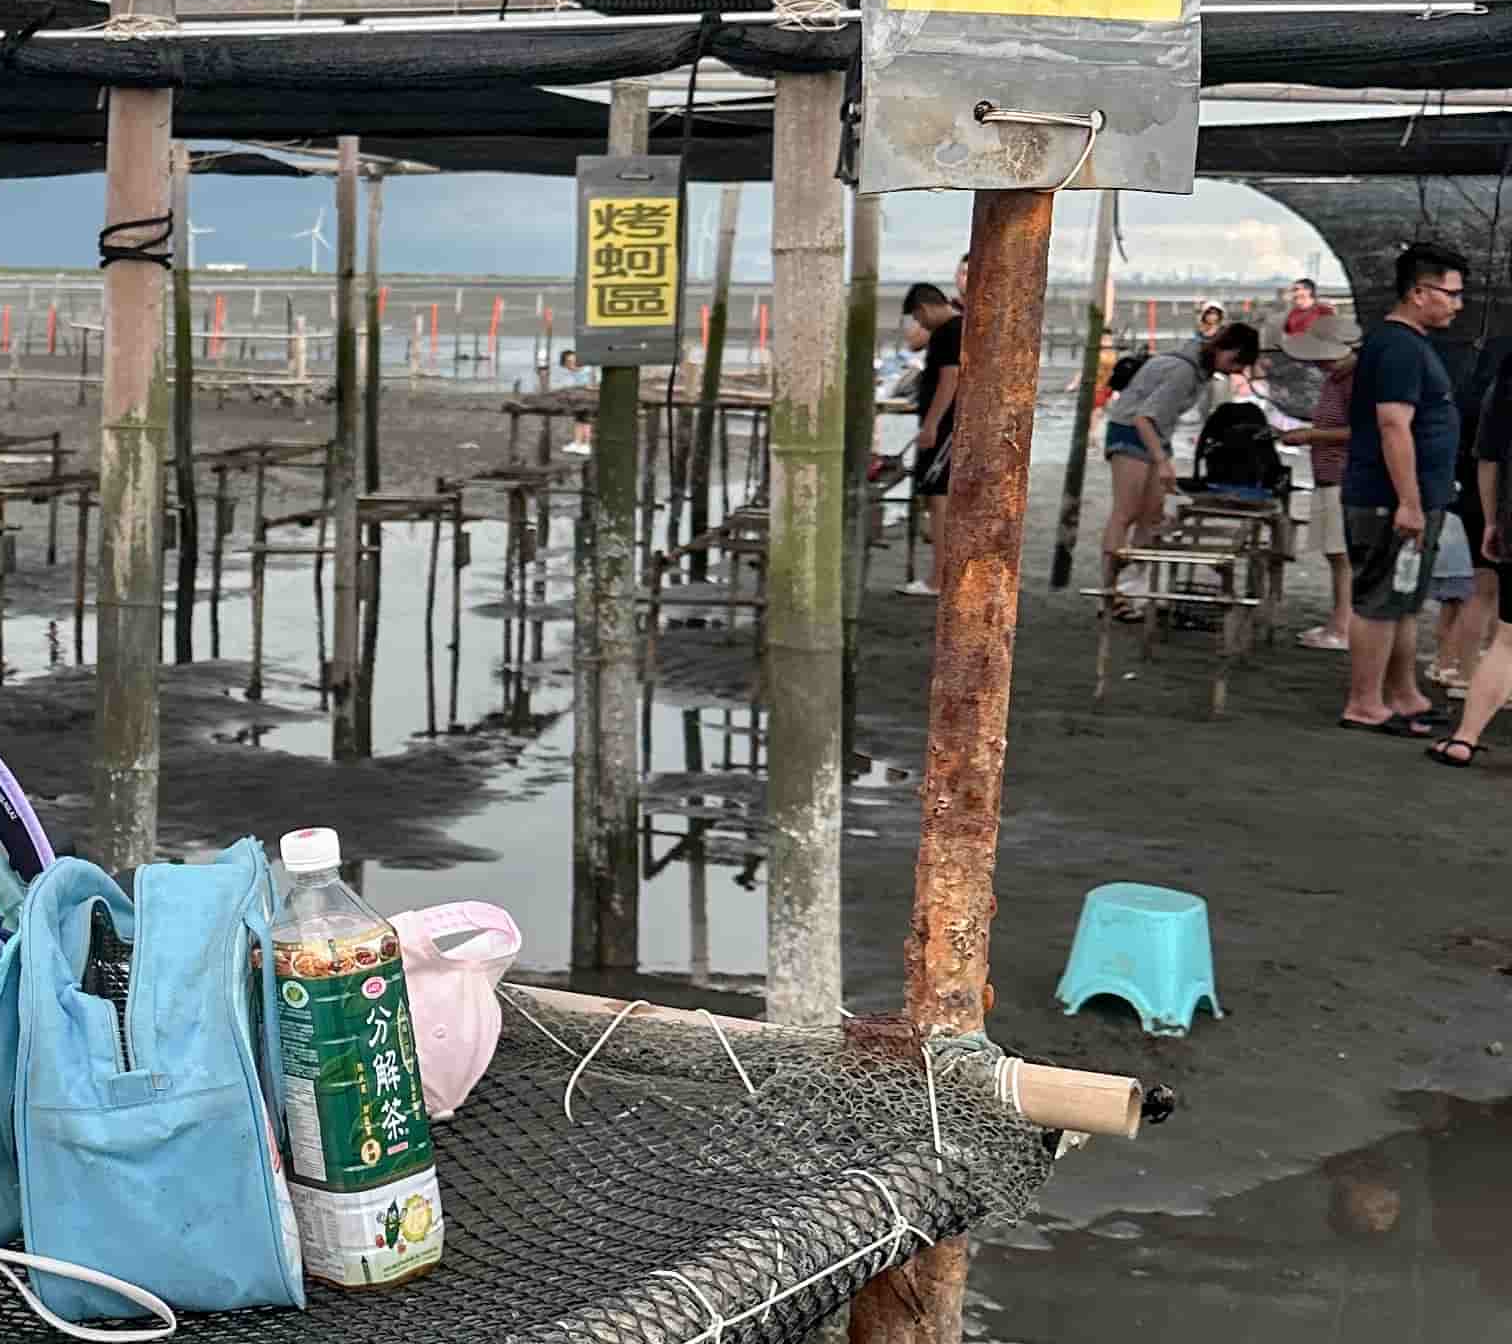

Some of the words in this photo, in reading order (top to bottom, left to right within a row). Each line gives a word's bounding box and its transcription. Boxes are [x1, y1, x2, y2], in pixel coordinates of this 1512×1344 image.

[592, 203, 673, 318] 烤蚵區
[366, 1006, 410, 1141] 分解茶
